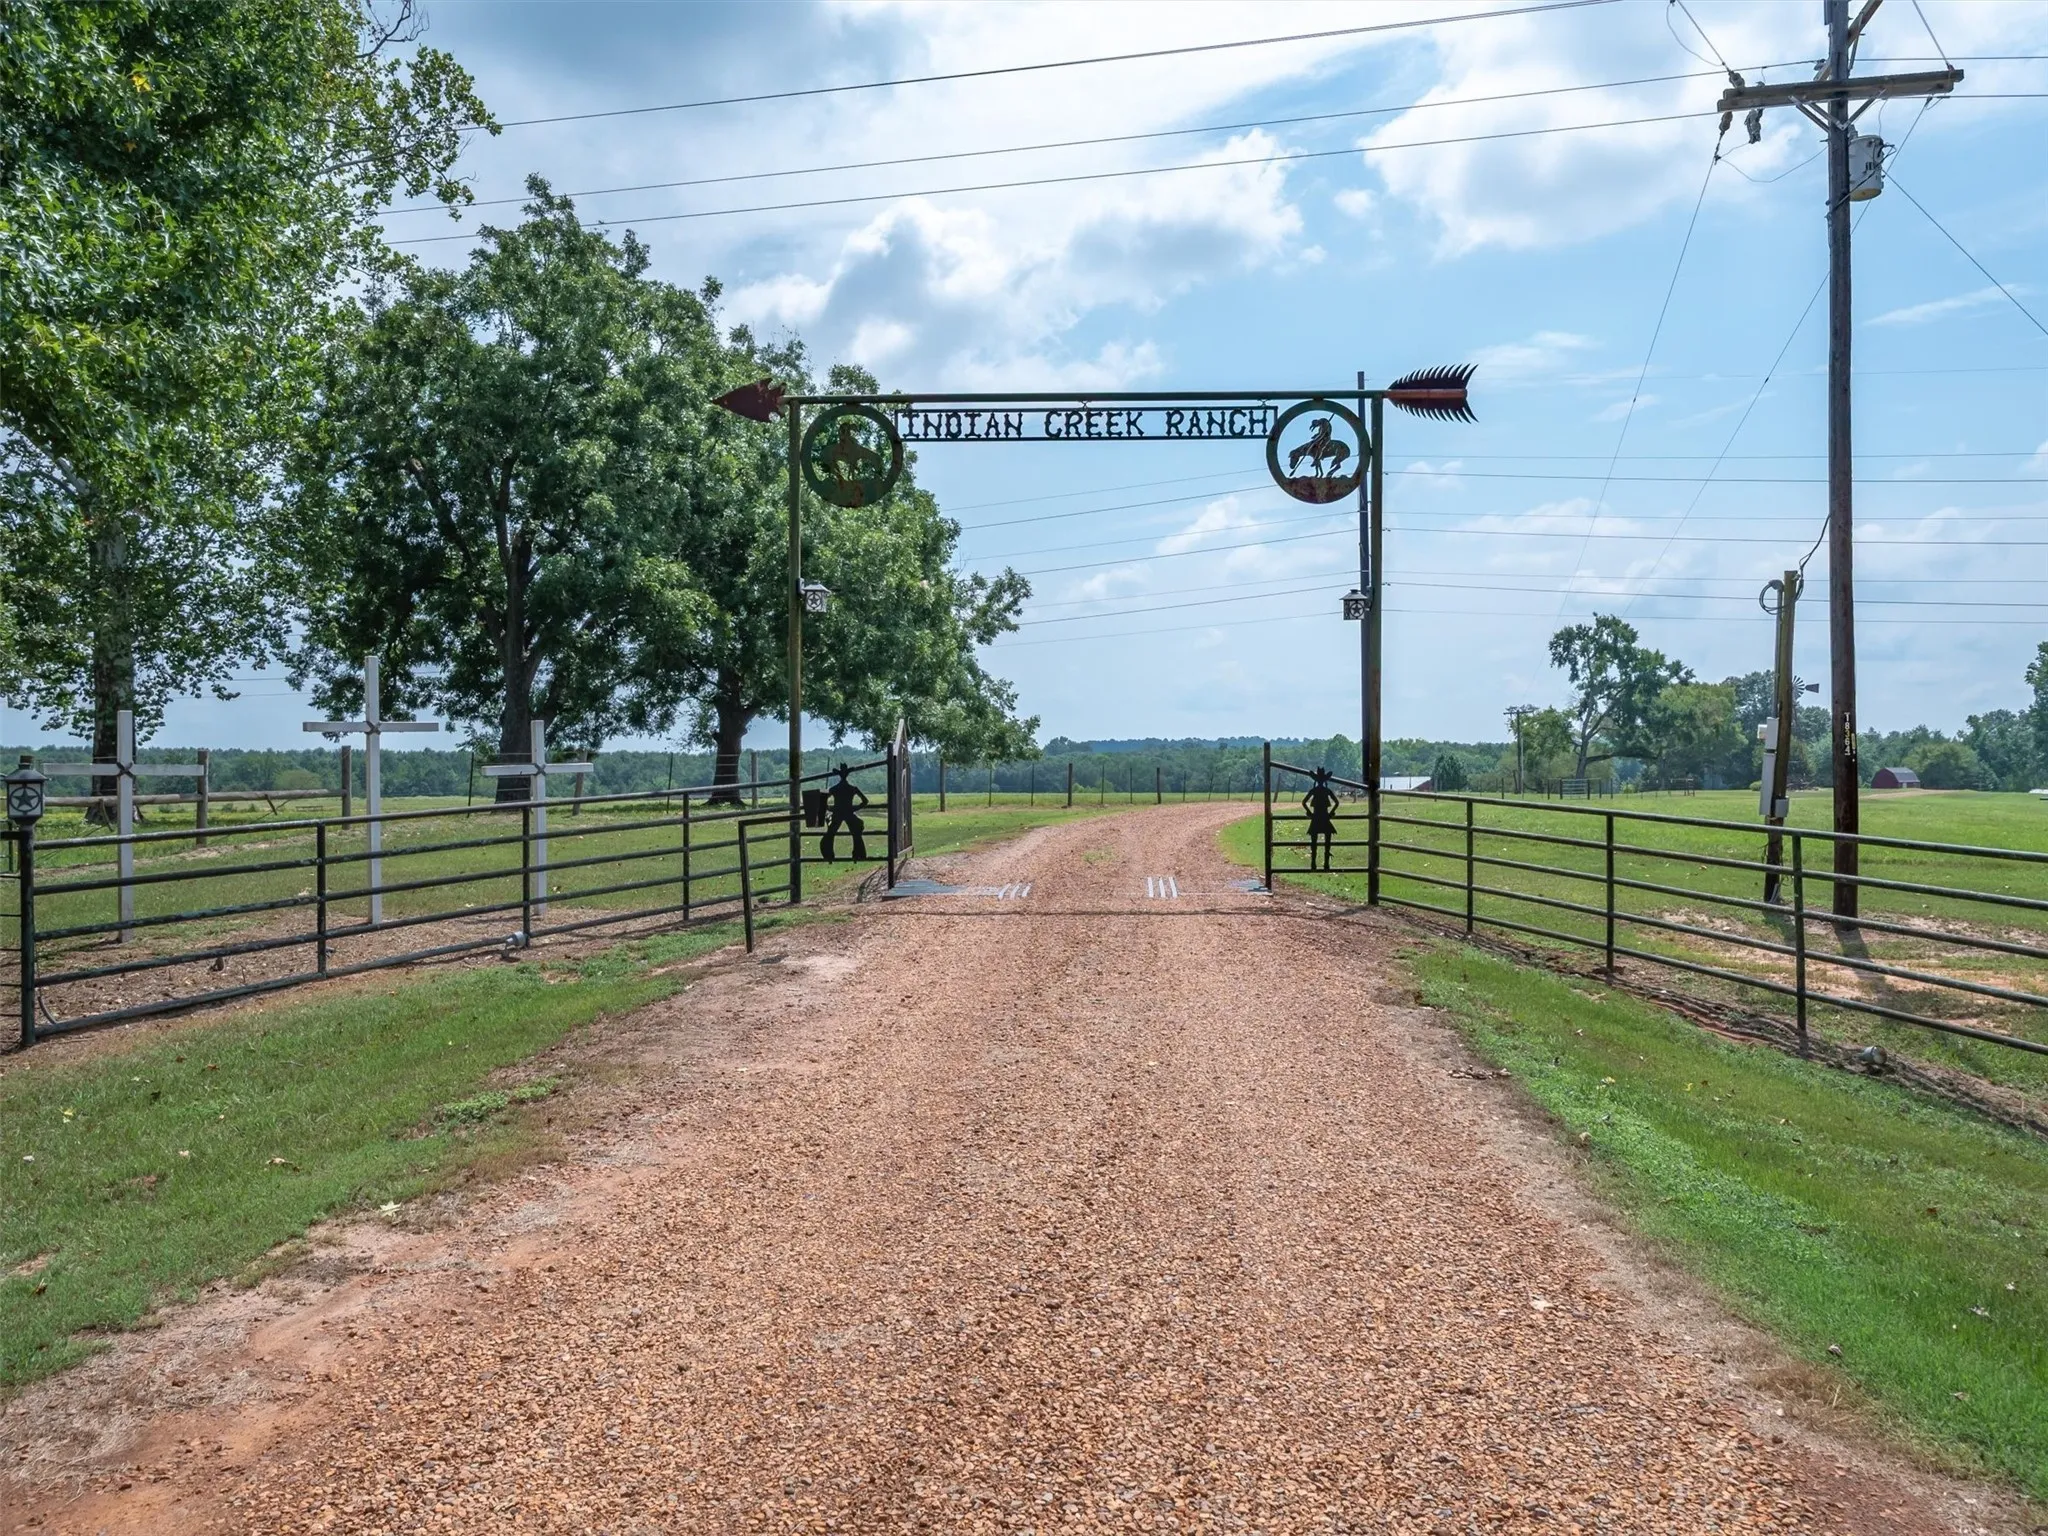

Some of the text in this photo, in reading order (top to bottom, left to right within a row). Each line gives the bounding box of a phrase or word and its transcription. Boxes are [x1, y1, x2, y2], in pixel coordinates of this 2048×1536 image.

[902, 409, 1268, 439] INDIAN CREEK RANCH
